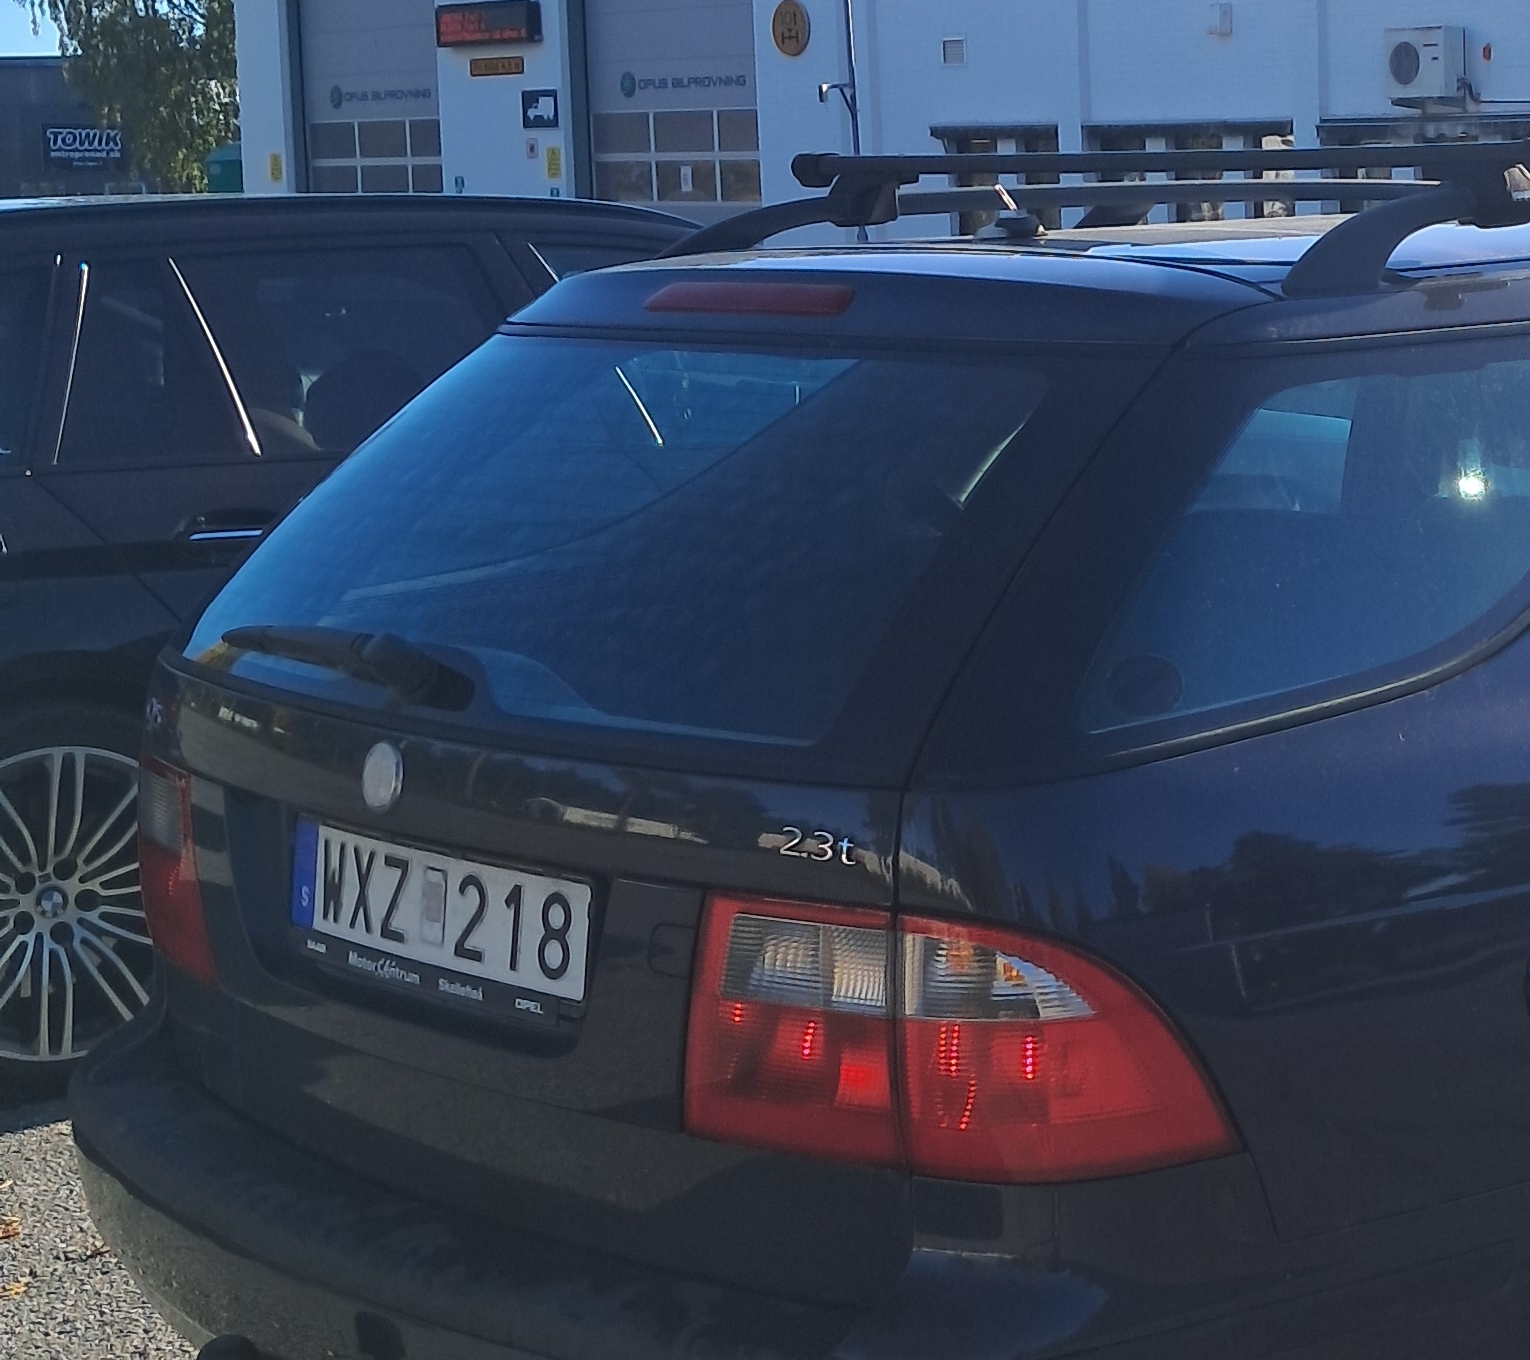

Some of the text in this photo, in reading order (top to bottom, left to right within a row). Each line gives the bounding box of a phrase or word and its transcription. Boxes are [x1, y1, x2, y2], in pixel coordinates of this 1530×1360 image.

[637, 74, 747, 90] OPUS BILPROVNING
[343, 88, 432, 101] OPUS BILPROVNING
[46, 128, 122, 150] TOWIK
[300, 885, 310, 908] S
[321, 838, 573, 981] WXZ 218
[514, 997, 544, 1015] OPEL
